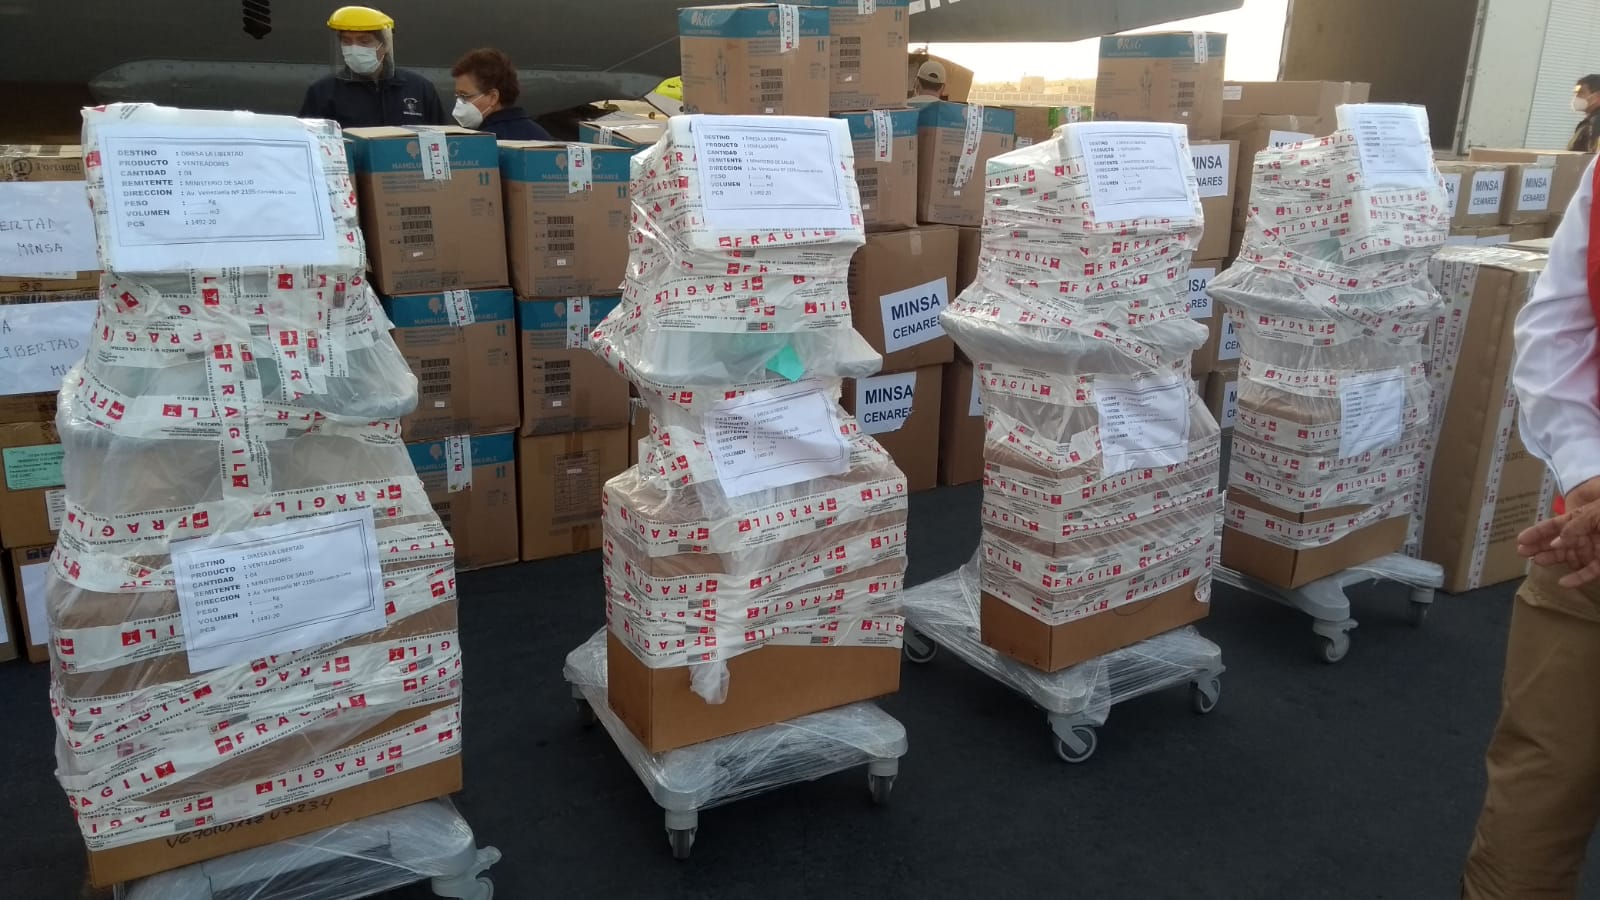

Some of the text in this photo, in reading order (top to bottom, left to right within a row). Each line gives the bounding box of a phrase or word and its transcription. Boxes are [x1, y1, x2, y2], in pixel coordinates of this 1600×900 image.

[1197, 176, 1223, 186] NARES
[1475, 180, 1499, 192] MINSA
[1525, 177, 1547, 188] MINSA
[123, 189, 172, 197] DIRECCION
[1472, 196, 1498, 206] CENARES
[1522, 194, 1545, 202] CENARES
[126, 209, 170, 217] VOLUMEN
[1281, 216, 1340, 233] FRAGIL
[660, 279, 749, 300] FRAGIL
[891, 293, 940, 320] MINSA
[865, 384, 913, 405] MINSA
[218, 363, 247, 472] FRAGIL
[990, 477, 1049, 502] FRAGIL
[1091, 473, 1143, 496] FRAGIL
[1256, 476, 1315, 498] FRAGIL
[275, 488, 385, 513] FRAGIL
[752, 503, 825, 528] FRAGIL
[77, 515, 188, 538] FRAGIL
[628, 516, 695, 539] FRAGIL
[188, 558, 225, 570] DESTINO
[190, 566, 236, 579] PRODUCTO
[192, 576, 235, 588] CANTIDAD
[631, 568, 702, 595] FRAGIL
[1054, 567, 1112, 588] FRAGIL
[1134, 571, 1183, 596] FRAGIL
[193, 584, 241, 598] REMITENTE
[195, 593, 240, 607] DIRECCION
[196, 607, 219, 616] PESO
[198, 612, 239, 625] VOLUMEN
[630, 628, 702, 650] FRAGIL
[277, 751, 385, 787] FRAGIL
